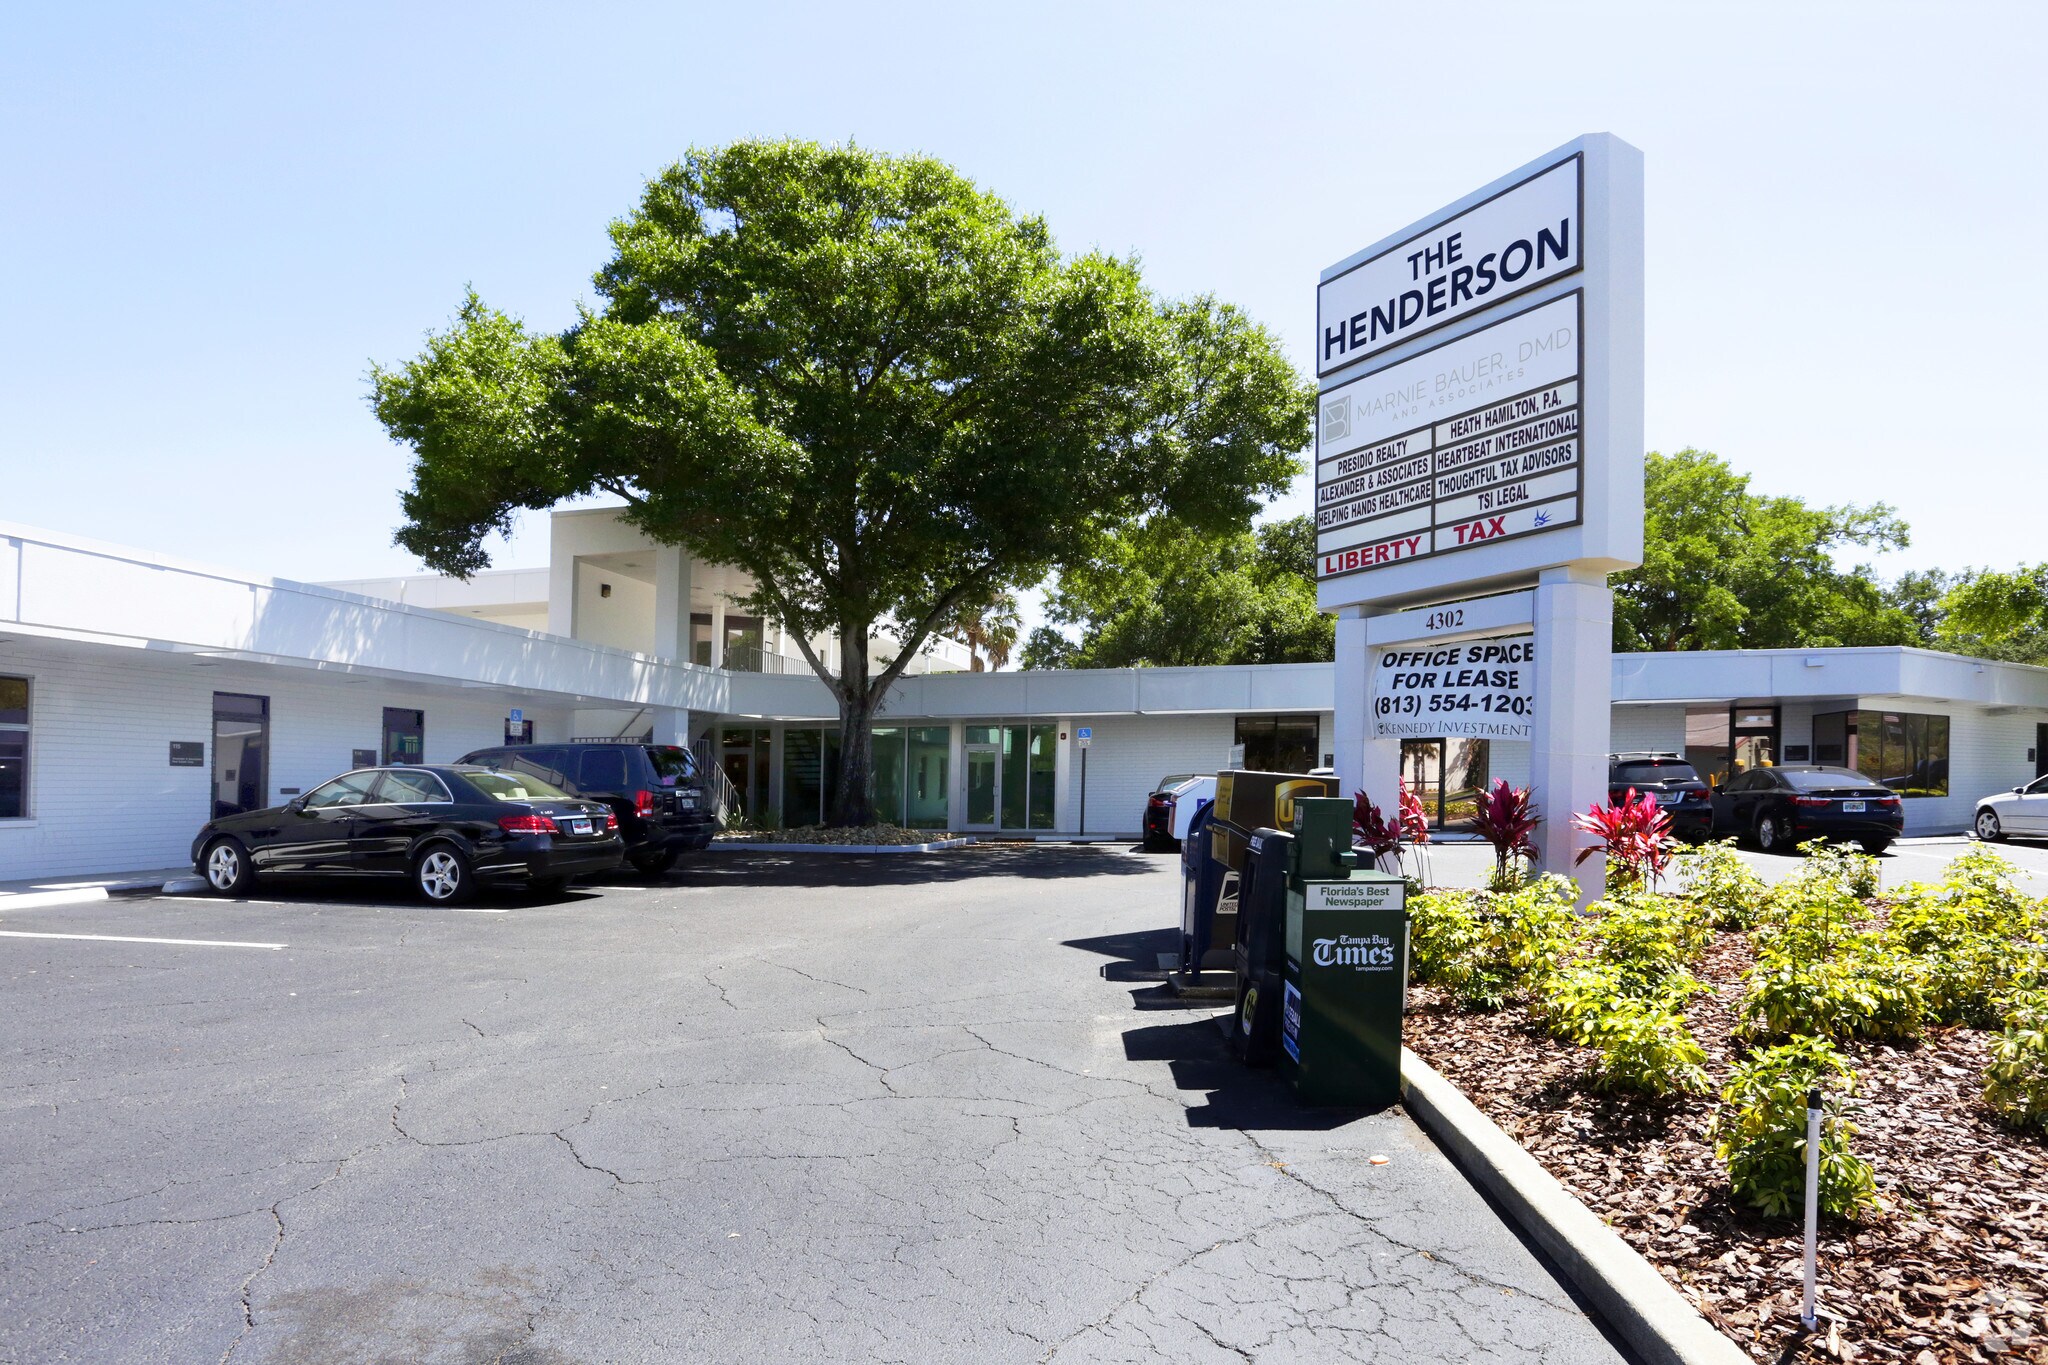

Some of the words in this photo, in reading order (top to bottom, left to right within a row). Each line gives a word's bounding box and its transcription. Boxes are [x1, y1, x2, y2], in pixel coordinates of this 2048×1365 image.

[1407, 231, 1463, 281] THE
[1325, 217, 1569, 361] HENDERSON
[1357, 379, 1426, 421] MARNIE
[1519, 327, 1572, 362] DMD
[1392, 406, 1418, 421] AND
[1429, 367, 1524, 408] ASSOCIATES
[1450, 414, 1481, 439] HEATH
[1485, 397, 1539, 431] HAMILTON,
[1543, 389, 1561, 409] P.A.
[1338, 453, 1374, 475] PRESIDIO
[1377, 440, 1408, 465] REALTY
[1437, 439, 1492, 470] HEARTBEAT
[1495, 413, 1578, 452] INTERNATIONAL
[1320, 474, 1365, 503] ALEXANDER
[1368, 475, 1374, 490] &
[1377, 457, 1428, 487] ASSOCIATES
[1438, 466, 1498, 496] THOUGHTFUL
[1501, 459, 1519, 478] TAX
[1522, 444, 1572, 472] ADVISORS
[1318, 502, 1349, 527] HELPING
[1351, 496, 1377, 518] HANDS
[1379, 482, 1431, 511] HEALTHCARE
[1478, 492, 1494, 510] TSI
[1497, 483, 1529, 506] LEGAL
[1325, 536, 1421, 574] LIBERTY
[1453, 515, 1506, 544] TAX
[1425, 609, 1464, 630] 4302
[1382, 648, 1460, 668] OFFICE
[1466, 643, 1533, 664] SPACE
[1392, 672, 1437, 690] FOR
[1442, 670, 1519, 690] LEASE
[1374, 695, 1421, 719] (813)
[1384, 722, 1436, 734] KENNEDY
[1320, 887, 1364, 896] Florida's
[1366, 887, 1390, 896] Best
[1325, 897, 1384, 908] Newspaper
[1312, 938, 1395, 967] Times
[1340, 934, 1371, 947] Tampa
[1372, 934, 1390, 946] Bay
